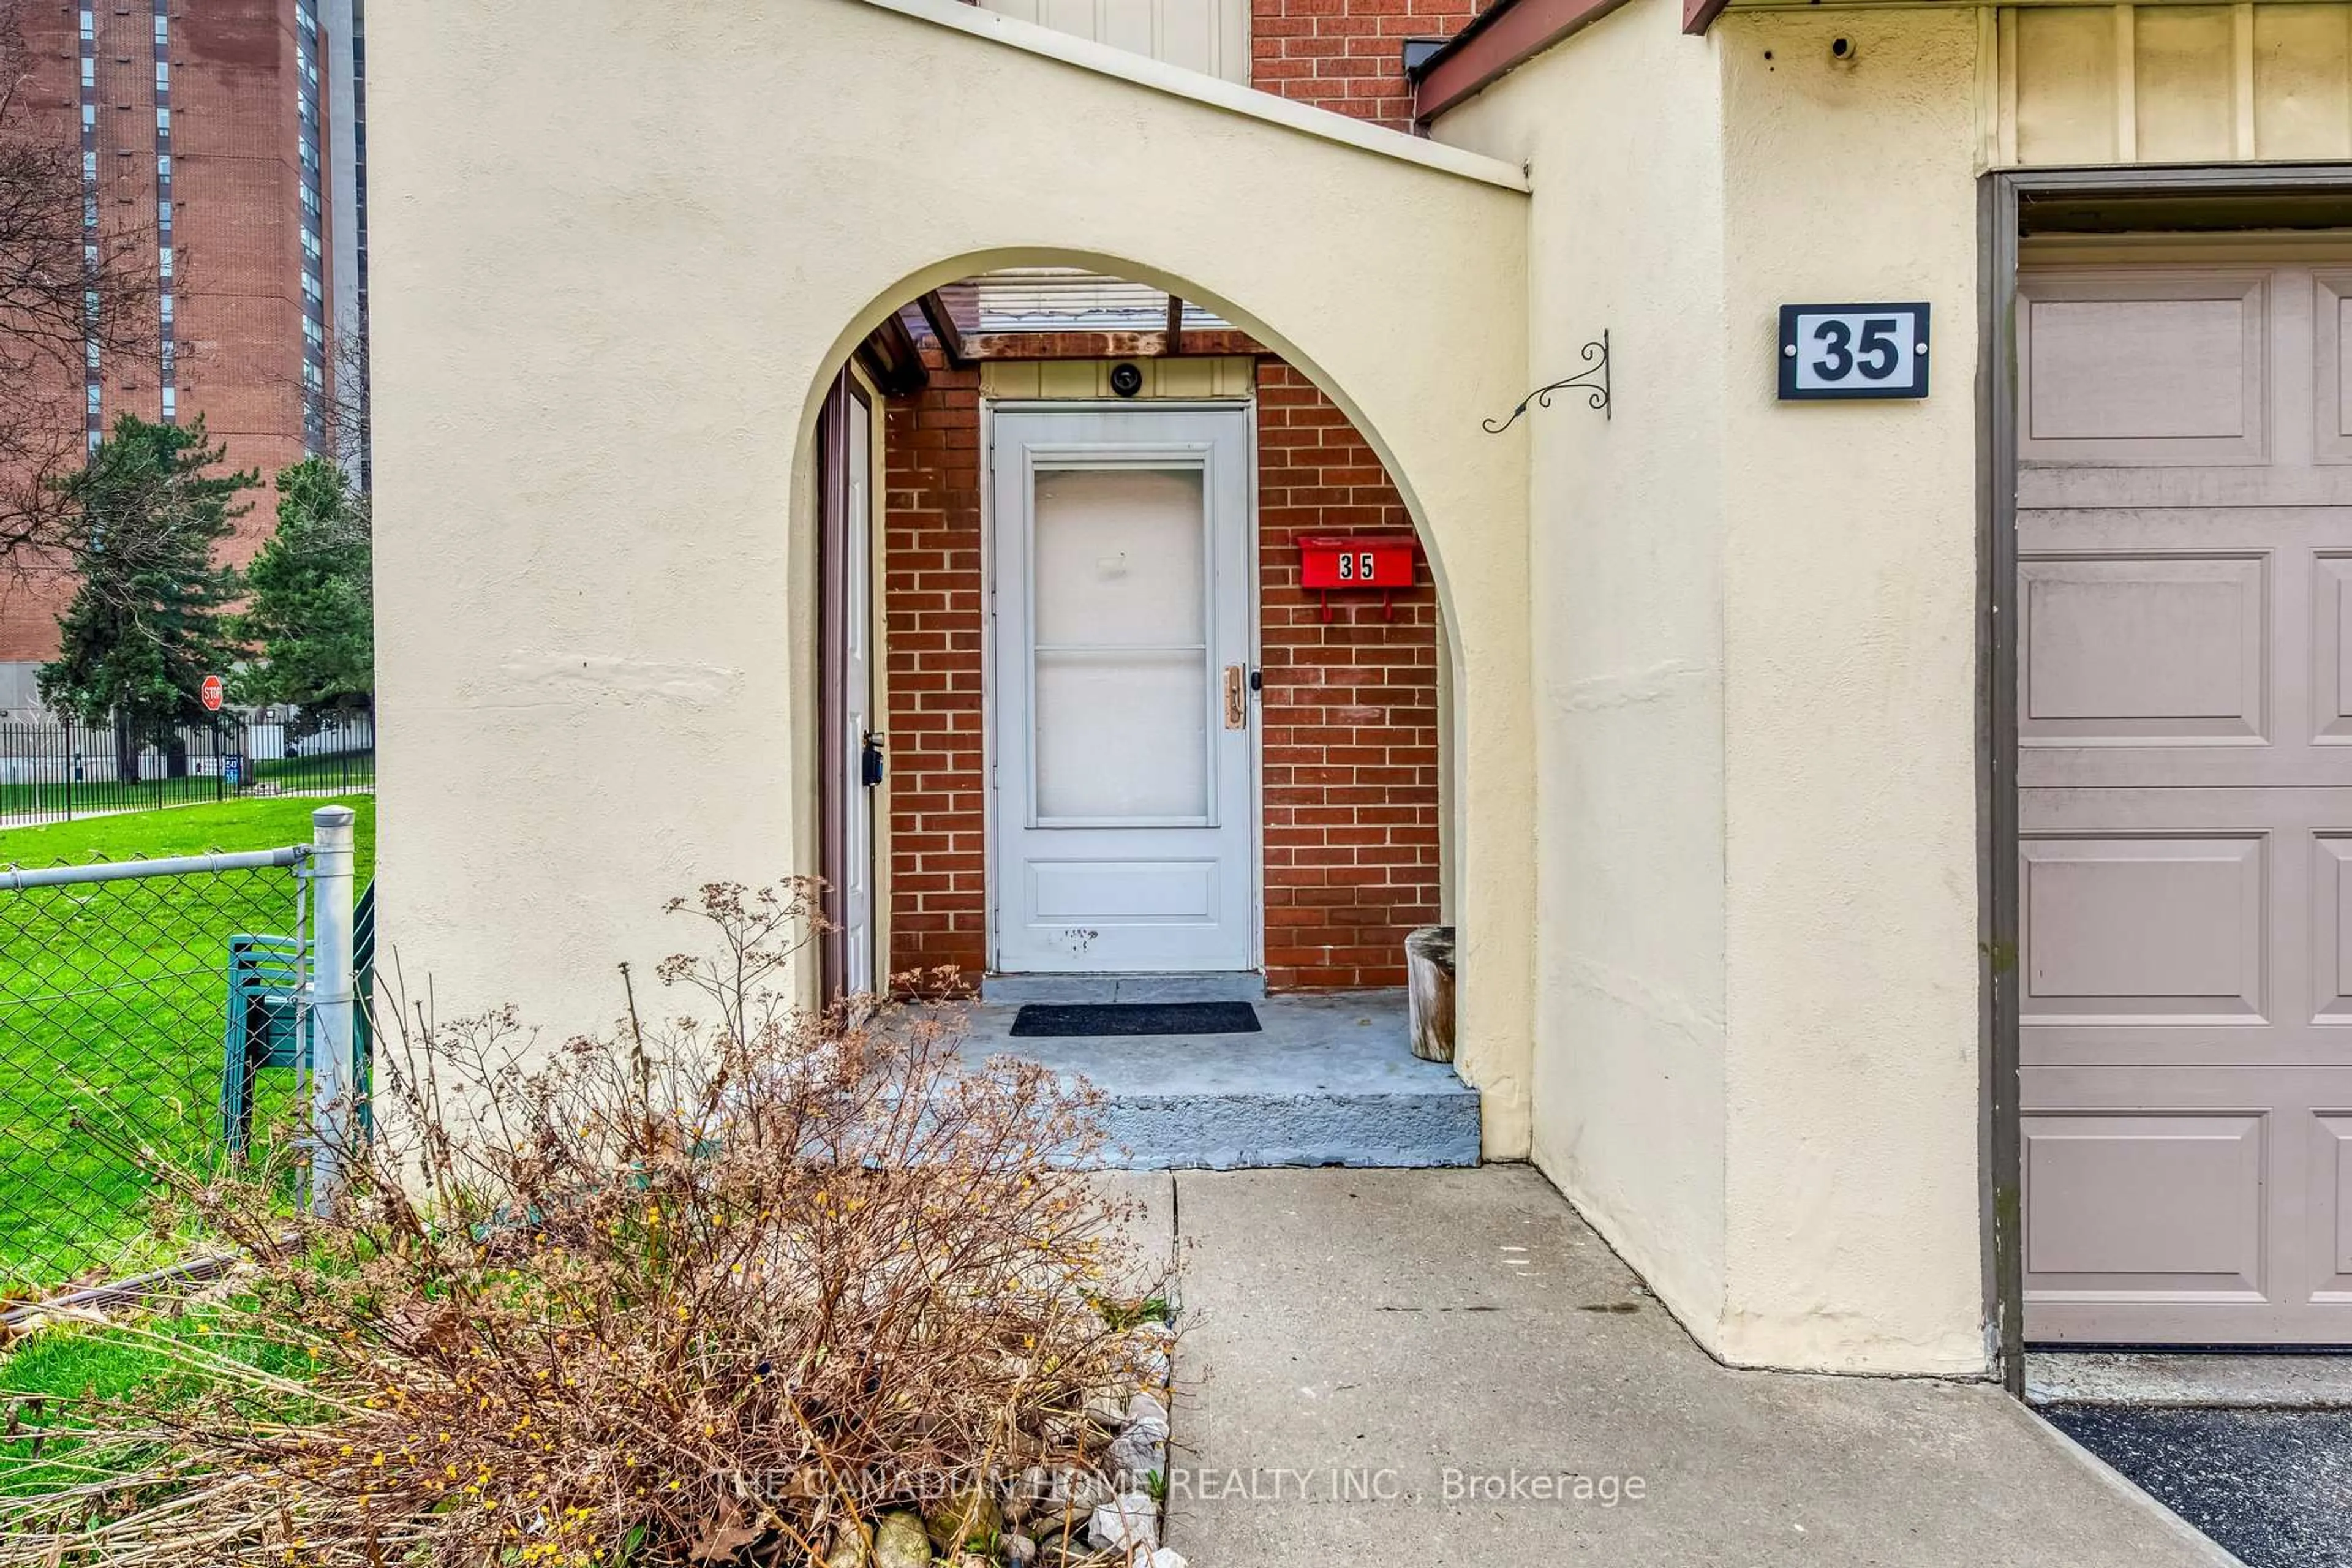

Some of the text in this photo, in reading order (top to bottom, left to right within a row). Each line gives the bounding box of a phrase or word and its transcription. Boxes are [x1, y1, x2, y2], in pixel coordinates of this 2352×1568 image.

[1813, 319, 1899, 381] 35
[1341, 555, 1373, 578] 35
[204, 686, 222, 699] STOP
